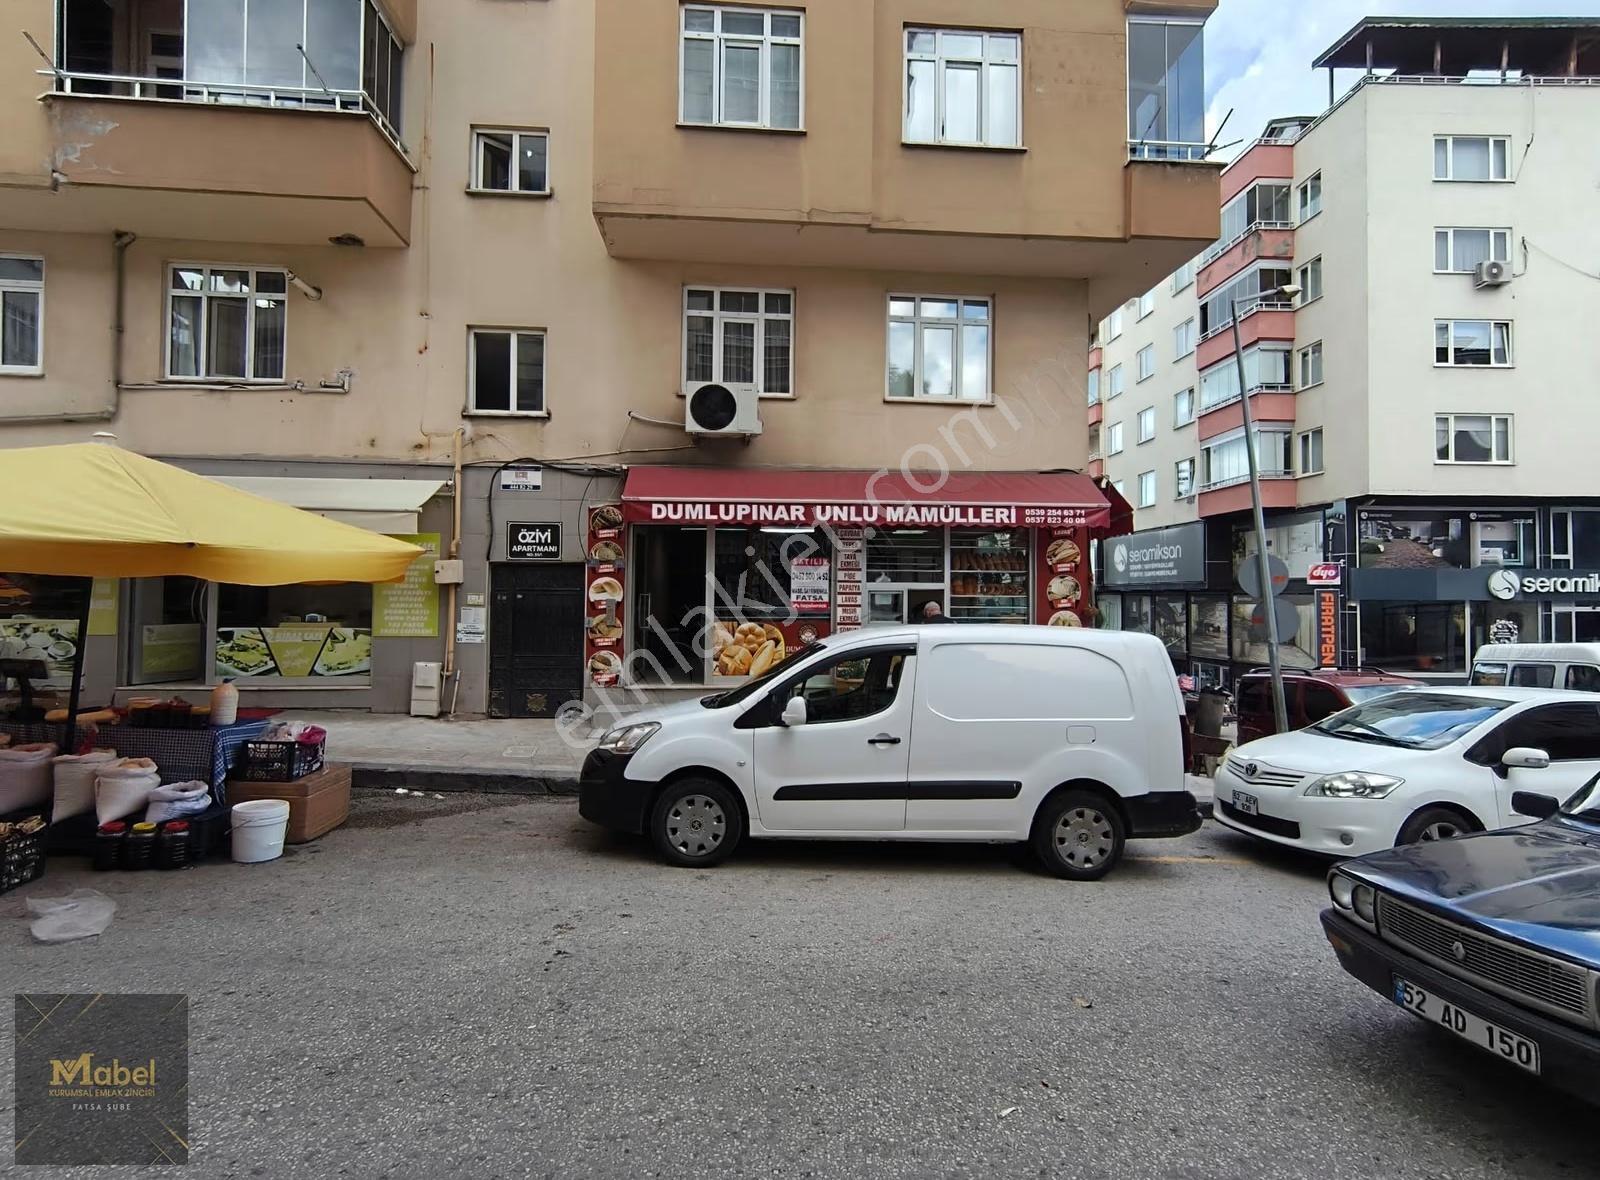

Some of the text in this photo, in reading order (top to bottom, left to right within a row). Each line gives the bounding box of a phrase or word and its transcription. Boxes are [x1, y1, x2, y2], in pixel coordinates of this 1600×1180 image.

[651, 503, 1017, 524] DUMLUPINAR UNLU MAMÜLLERİ
[1025, 508, 1045, 516] 0539
[518, 528, 551, 543] ÖZİYİ
[1128, 543, 1182, 563] seramiksan
[1312, 565, 1336, 579] dyo
[1319, 591, 1336, 665] FIRATPEN
[1403, 985, 1532, 1065] 52 AD 150
